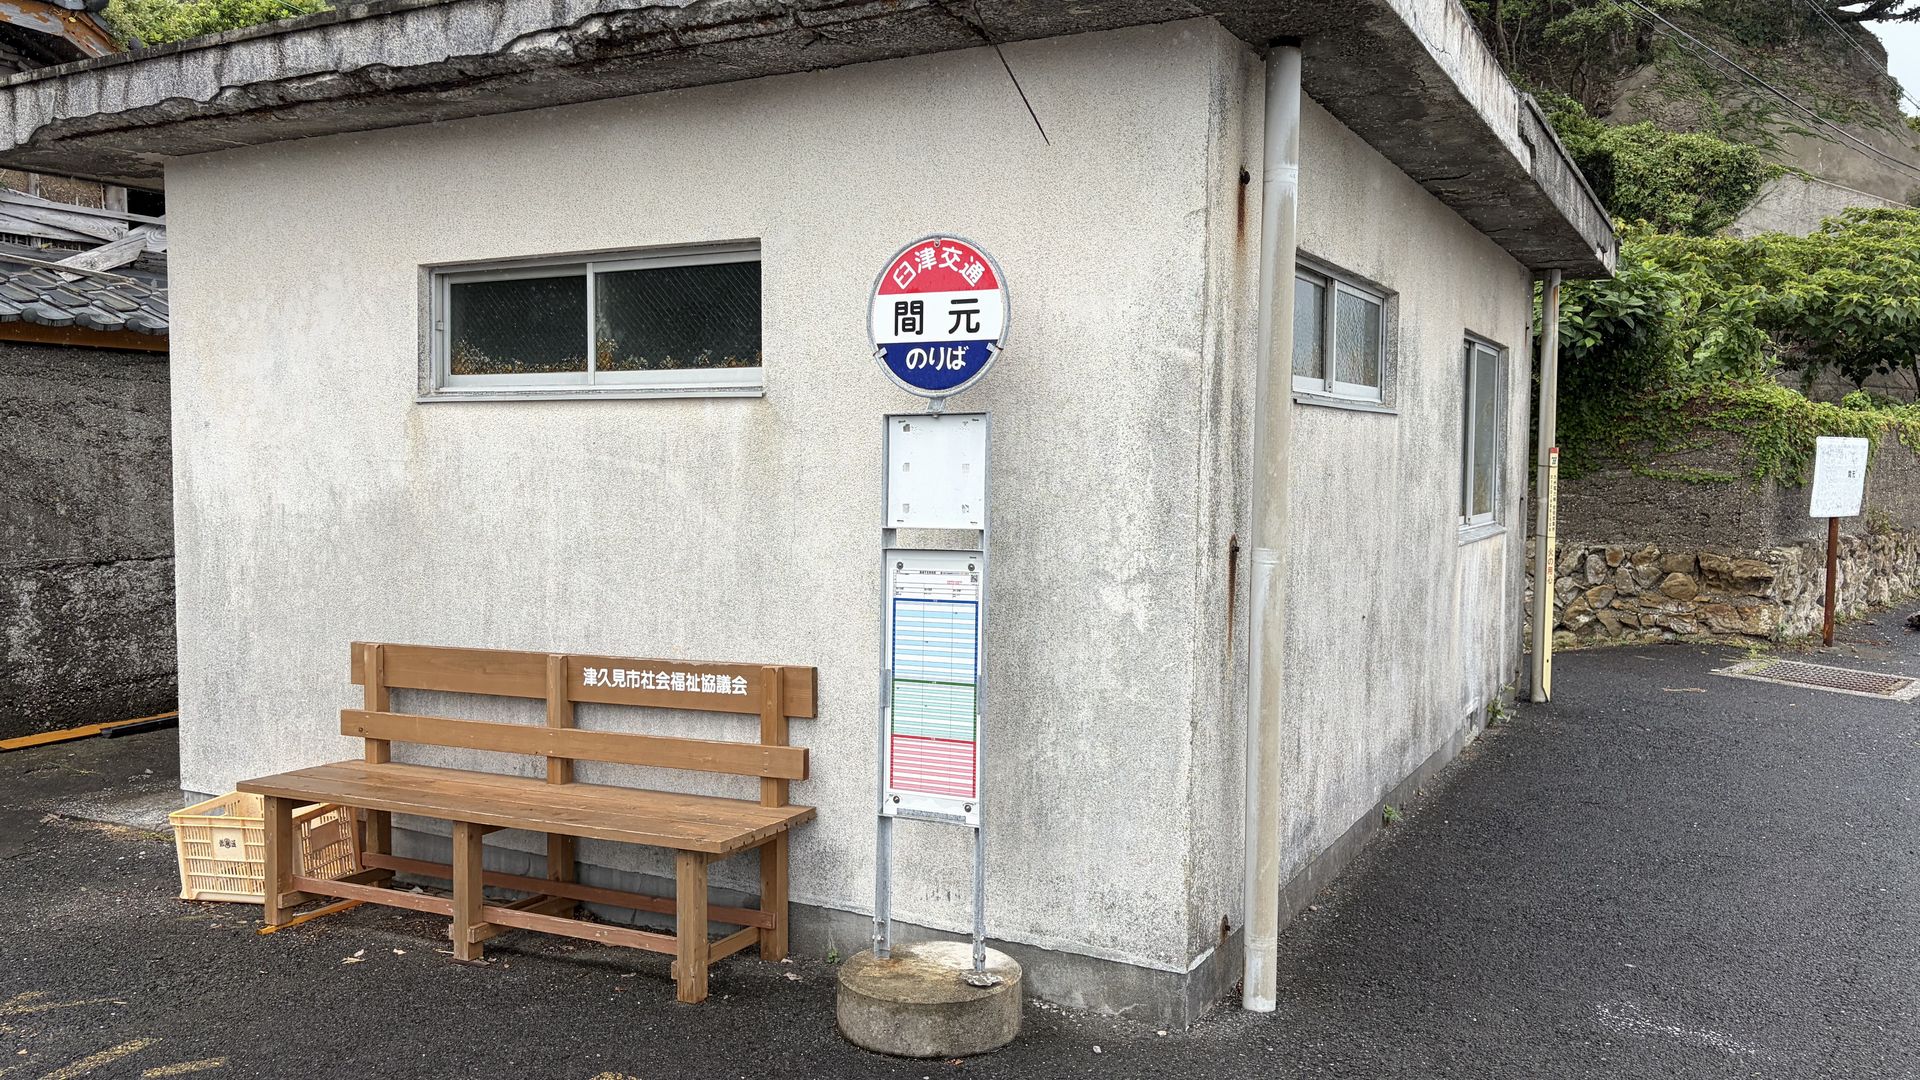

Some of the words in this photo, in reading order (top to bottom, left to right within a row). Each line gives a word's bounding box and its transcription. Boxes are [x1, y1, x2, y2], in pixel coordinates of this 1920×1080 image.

[893, 246, 986, 290] 臼津交通
[894, 298, 980, 336] 間元
[906, 346, 969, 370] のりば
[583, 666, 748, 696] 津久見市社会福祉協議会
